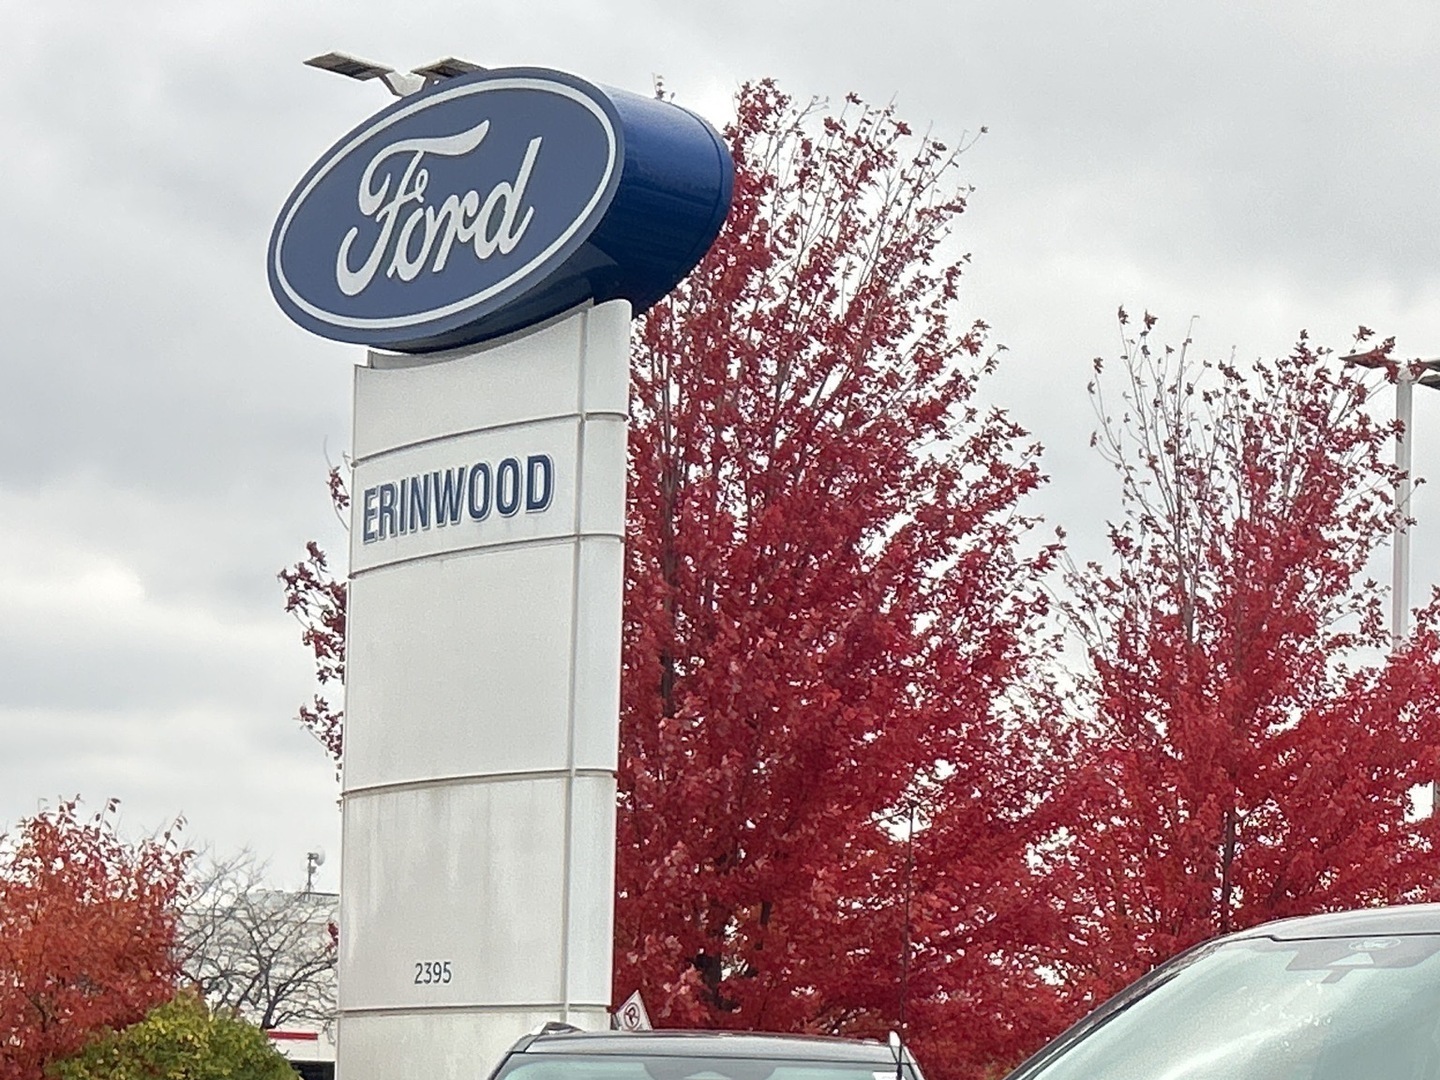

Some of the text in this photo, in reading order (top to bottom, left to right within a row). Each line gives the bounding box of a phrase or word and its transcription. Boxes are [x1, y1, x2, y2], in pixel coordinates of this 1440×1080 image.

[335, 118, 543, 296] Ford
[362, 453, 555, 545] ERINWOOD
[414, 961, 452, 985] 2395
